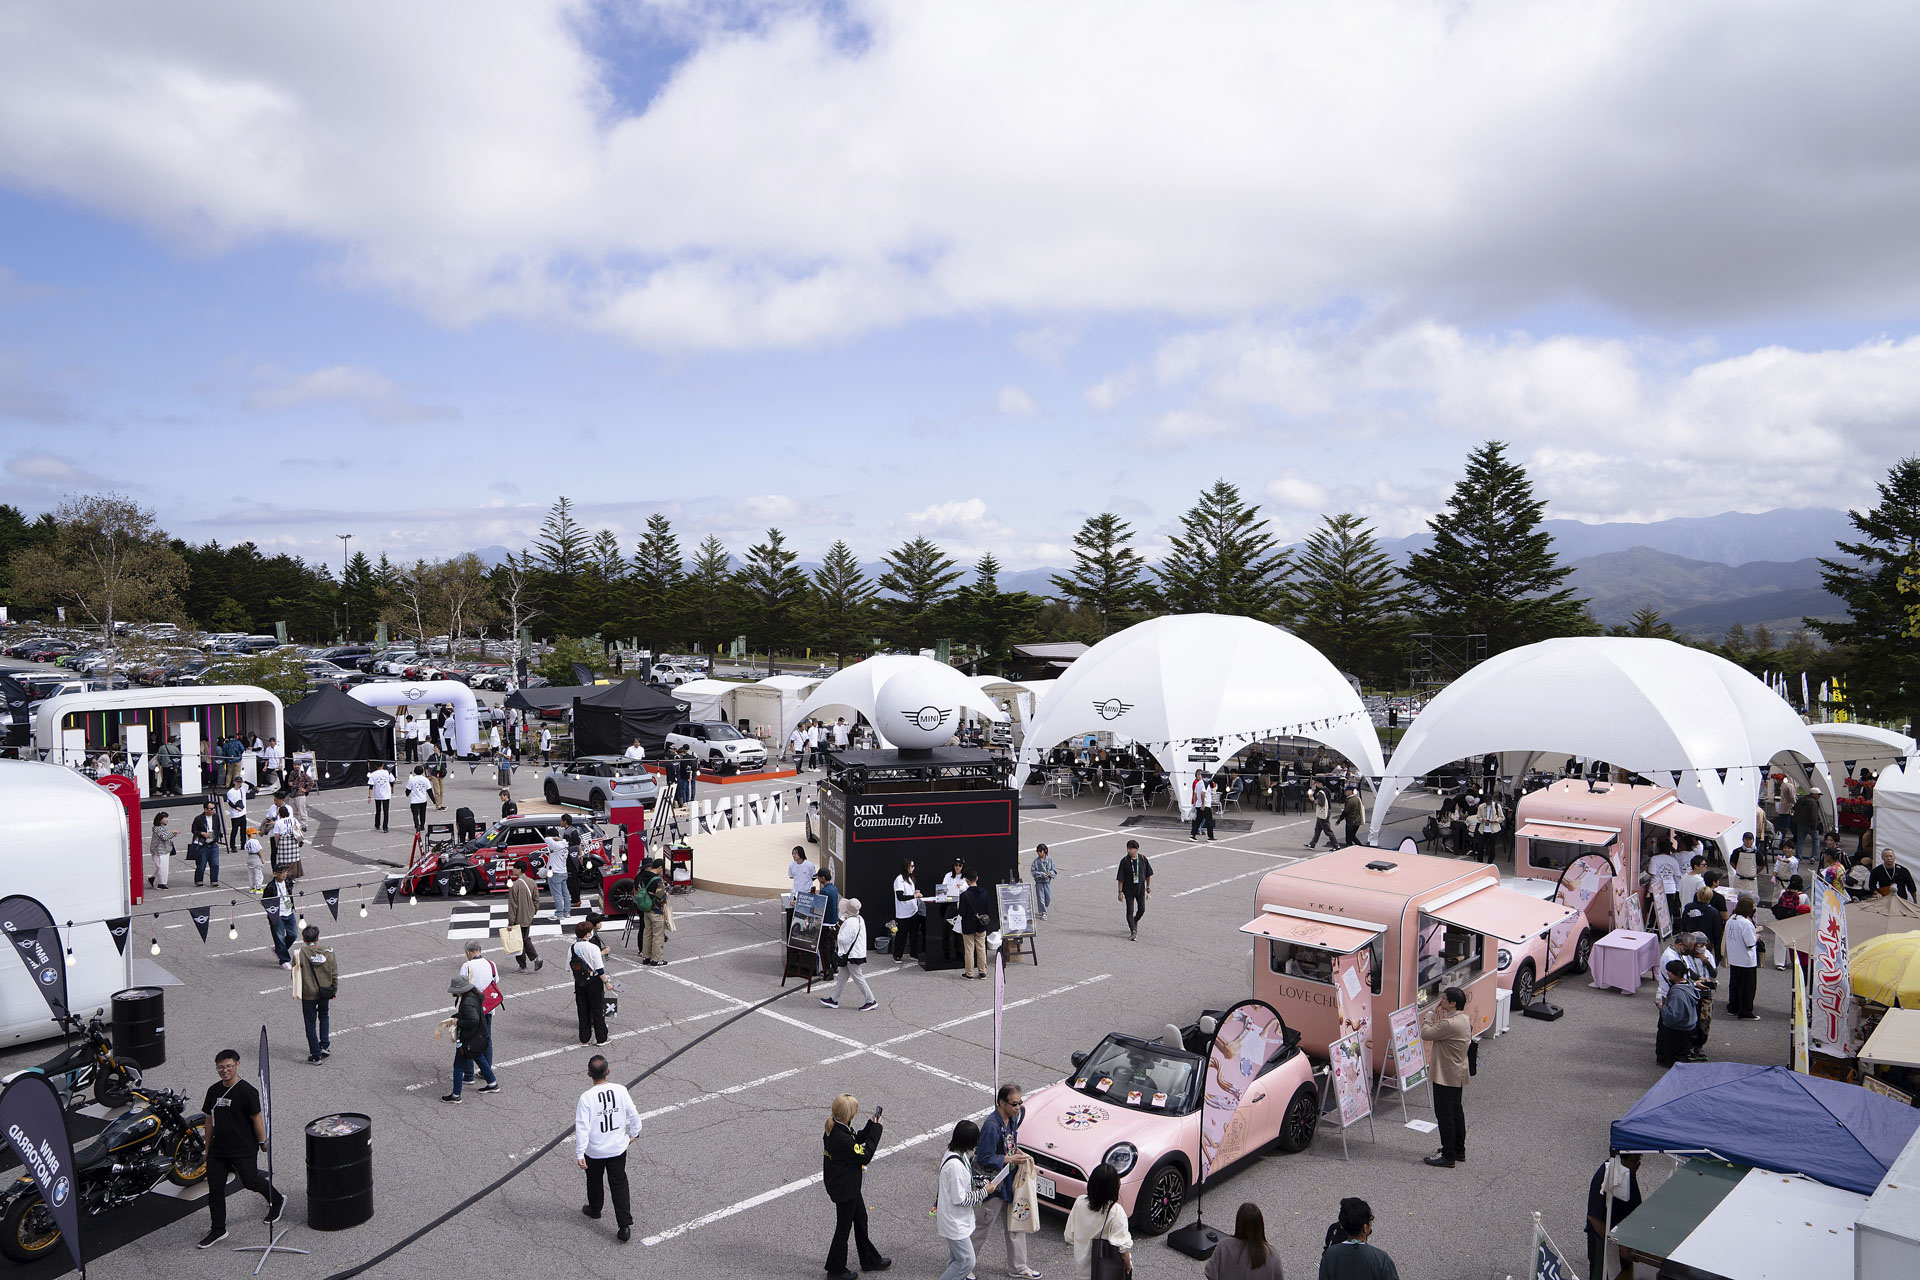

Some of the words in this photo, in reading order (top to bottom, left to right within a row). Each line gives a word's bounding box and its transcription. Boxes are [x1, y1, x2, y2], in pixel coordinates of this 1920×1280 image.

[1104, 705, 1119, 713] MINI
[920, 715, 939, 723] MINI
[853, 804, 884, 816] MINI
[853, 815, 916, 828] Community
[918, 813, 943, 825] Hub.
[1279, 984, 1311, 1003] LOVE
